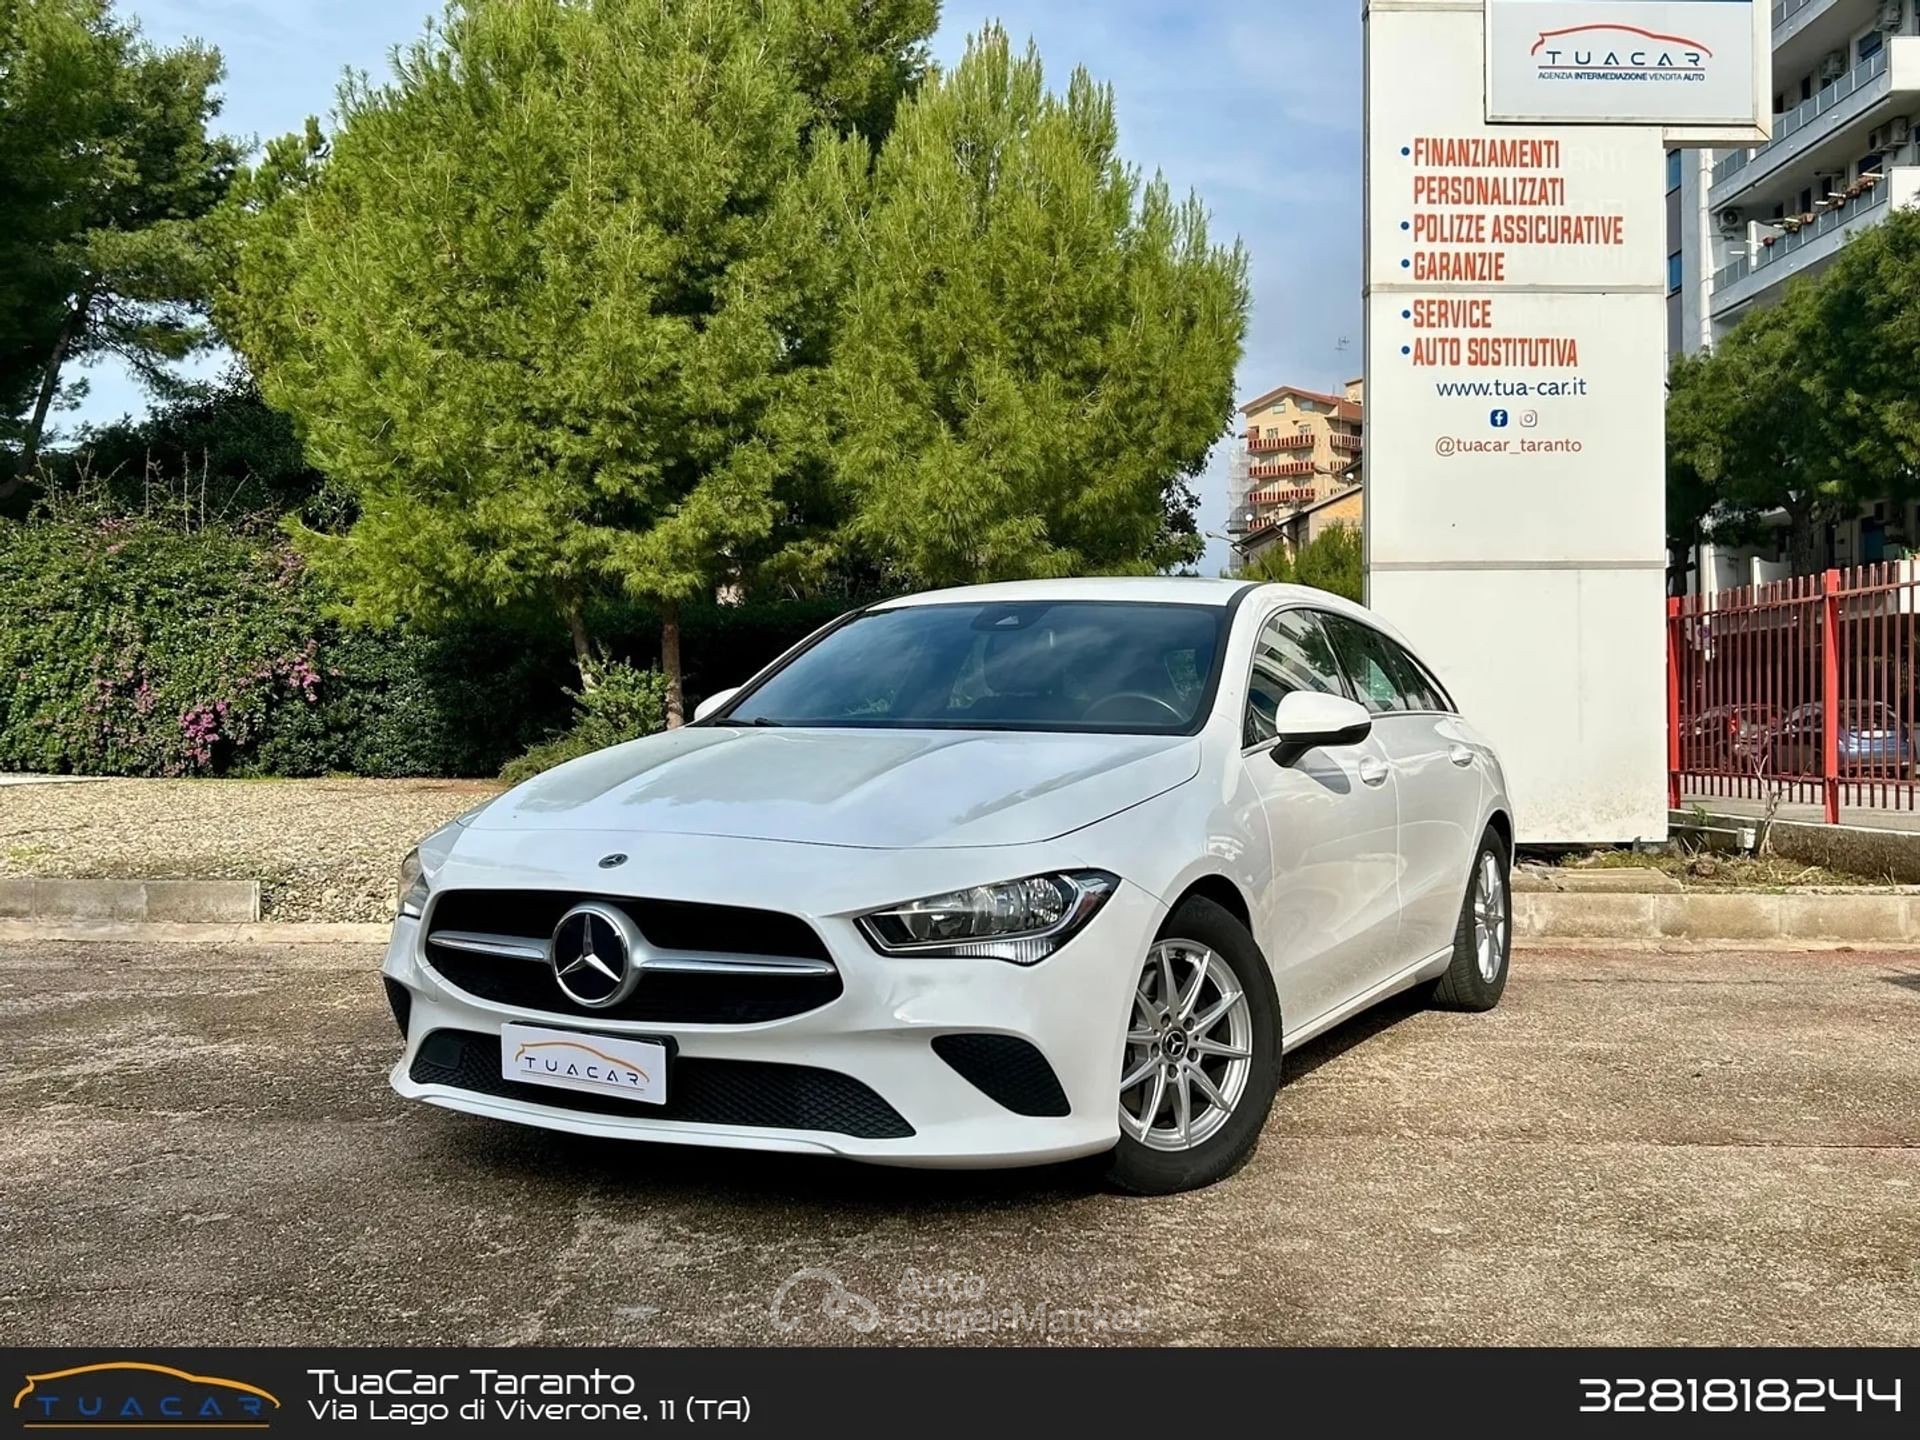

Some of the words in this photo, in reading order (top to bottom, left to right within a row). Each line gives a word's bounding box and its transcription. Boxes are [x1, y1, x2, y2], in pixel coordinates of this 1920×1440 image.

[1546, 51, 1700, 66] TUACAR
[1538, 72, 1573, 80] AGENZIA
[1574, 72, 1648, 81] INTERMEDIAZIONE
[1650, 73, 1682, 81] VENDITA
[1414, 137, 1559, 168] FINANZIAMENTI
[1414, 176, 1564, 206] PERSONALIZZATI
[1414, 214, 1486, 243] POLIZZE
[1491, 215, 1623, 244] ASSICURATIVE
[1414, 252, 1504, 281] GARANZIE
[1413, 299, 1492, 328] SERVICE
[1413, 337, 1461, 366] AUTO
[1467, 338, 1578, 367] SOSTITUTIVA
[1436, 376, 1587, 396] www.tua-car.it
[1435, 436, 1583, 457] @tuacar_taranto
[525, 1056, 639, 1085] TUACAR
